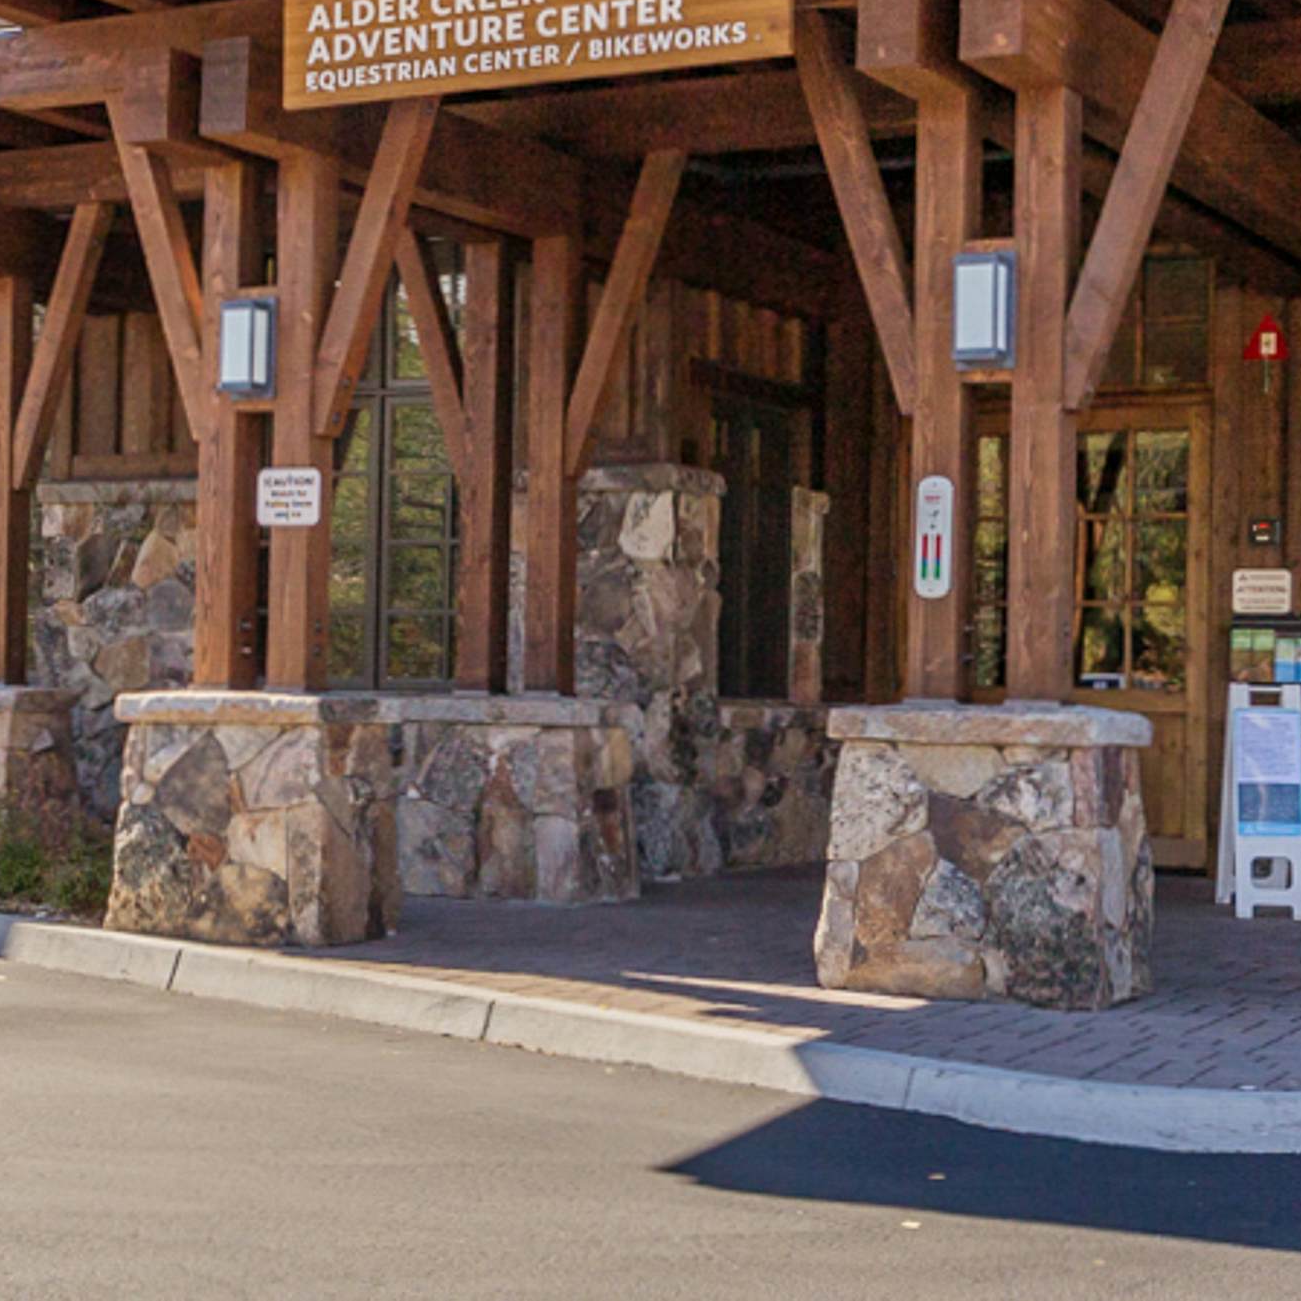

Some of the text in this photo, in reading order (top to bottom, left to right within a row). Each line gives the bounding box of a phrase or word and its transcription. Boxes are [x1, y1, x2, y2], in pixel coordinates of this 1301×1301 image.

[305, 21, 747, 93] EQUESTRIAN CENTER / BIKEWORKS
[307, 11, 525, 65] ADVENTURE
